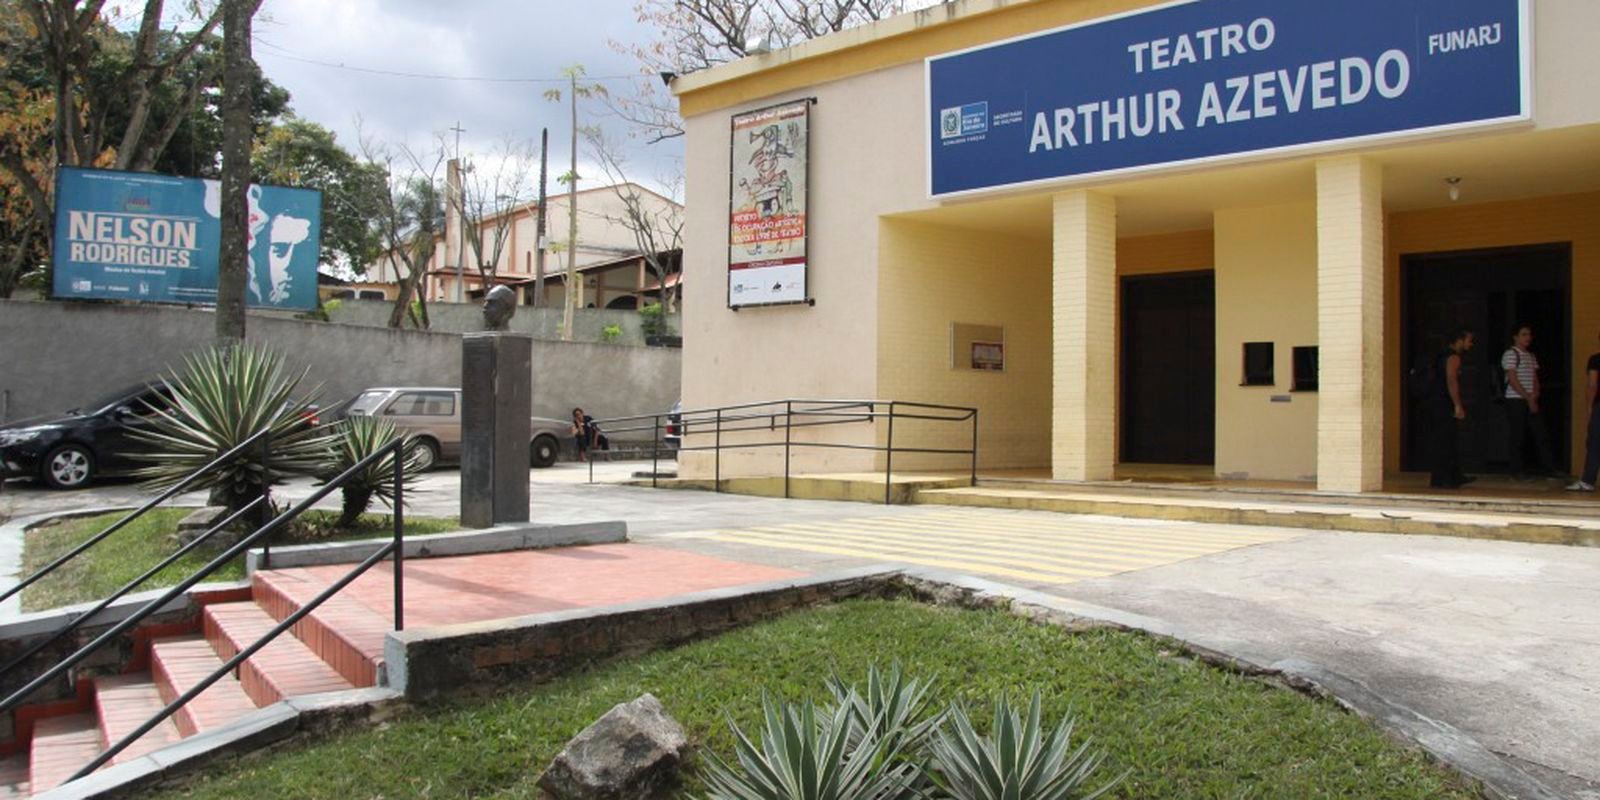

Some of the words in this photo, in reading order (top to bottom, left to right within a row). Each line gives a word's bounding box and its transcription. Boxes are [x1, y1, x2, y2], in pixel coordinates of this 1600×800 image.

[1127, 17, 1276, 74] TEATRO
[1429, 22, 1501, 55] FUNARJ
[1029, 88, 1185, 153] ARTHUR
[1196, 49, 1410, 128] AZEVEDO
[69, 210, 197, 250] NELSON
[71, 241, 191, 269] RODRIGUES
